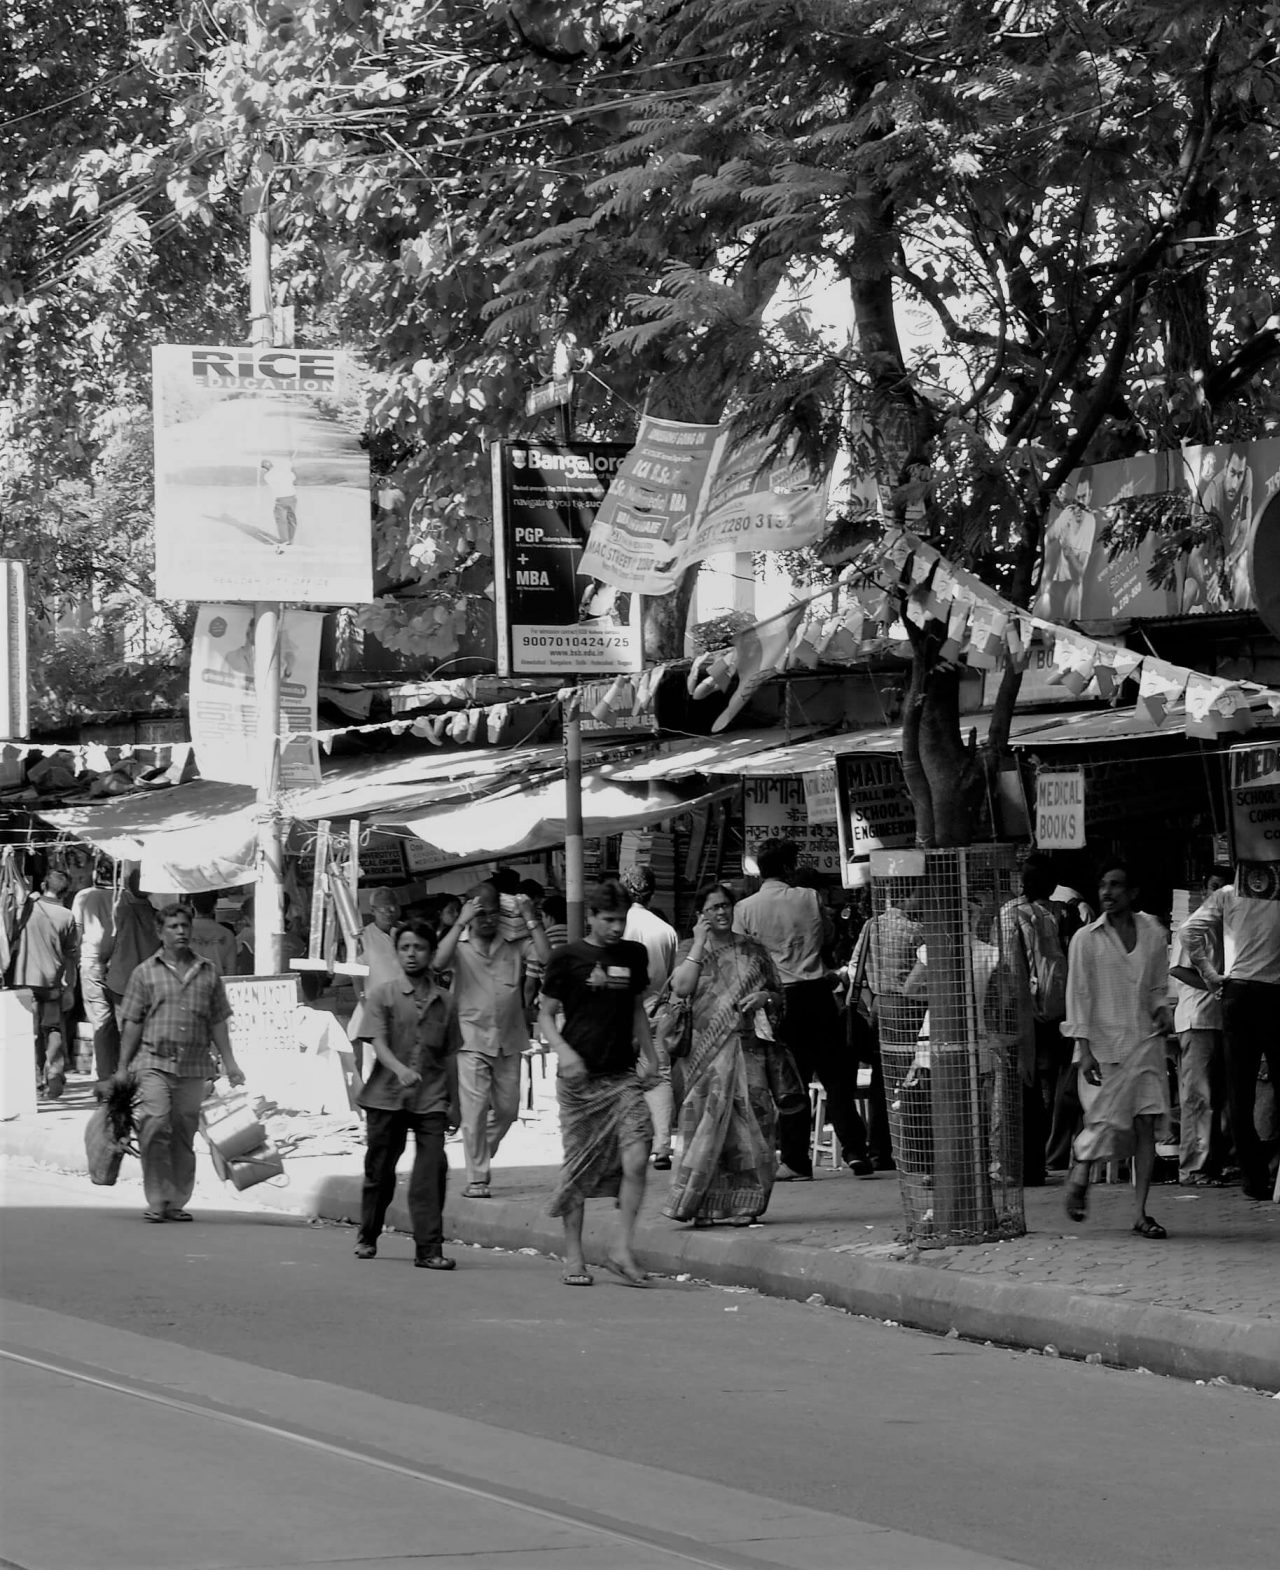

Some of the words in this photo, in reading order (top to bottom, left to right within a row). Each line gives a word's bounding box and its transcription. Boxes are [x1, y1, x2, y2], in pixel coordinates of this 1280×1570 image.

[192, 351, 334, 380] RICE
[195, 375, 335, 392] EDUCATION
[515, 527, 544, 543] PGP
[516, 570, 550, 586] MBA
[522, 635, 630, 648] 9007010424/25
[850, 790, 882, 804] STALL
[1039, 779, 1082, 807] MEDICAL
[1236, 788, 1277, 806] SCHOOL
[855, 802, 905, 822] SCHOOL
[1040, 813, 1076, 840] BOOKS
